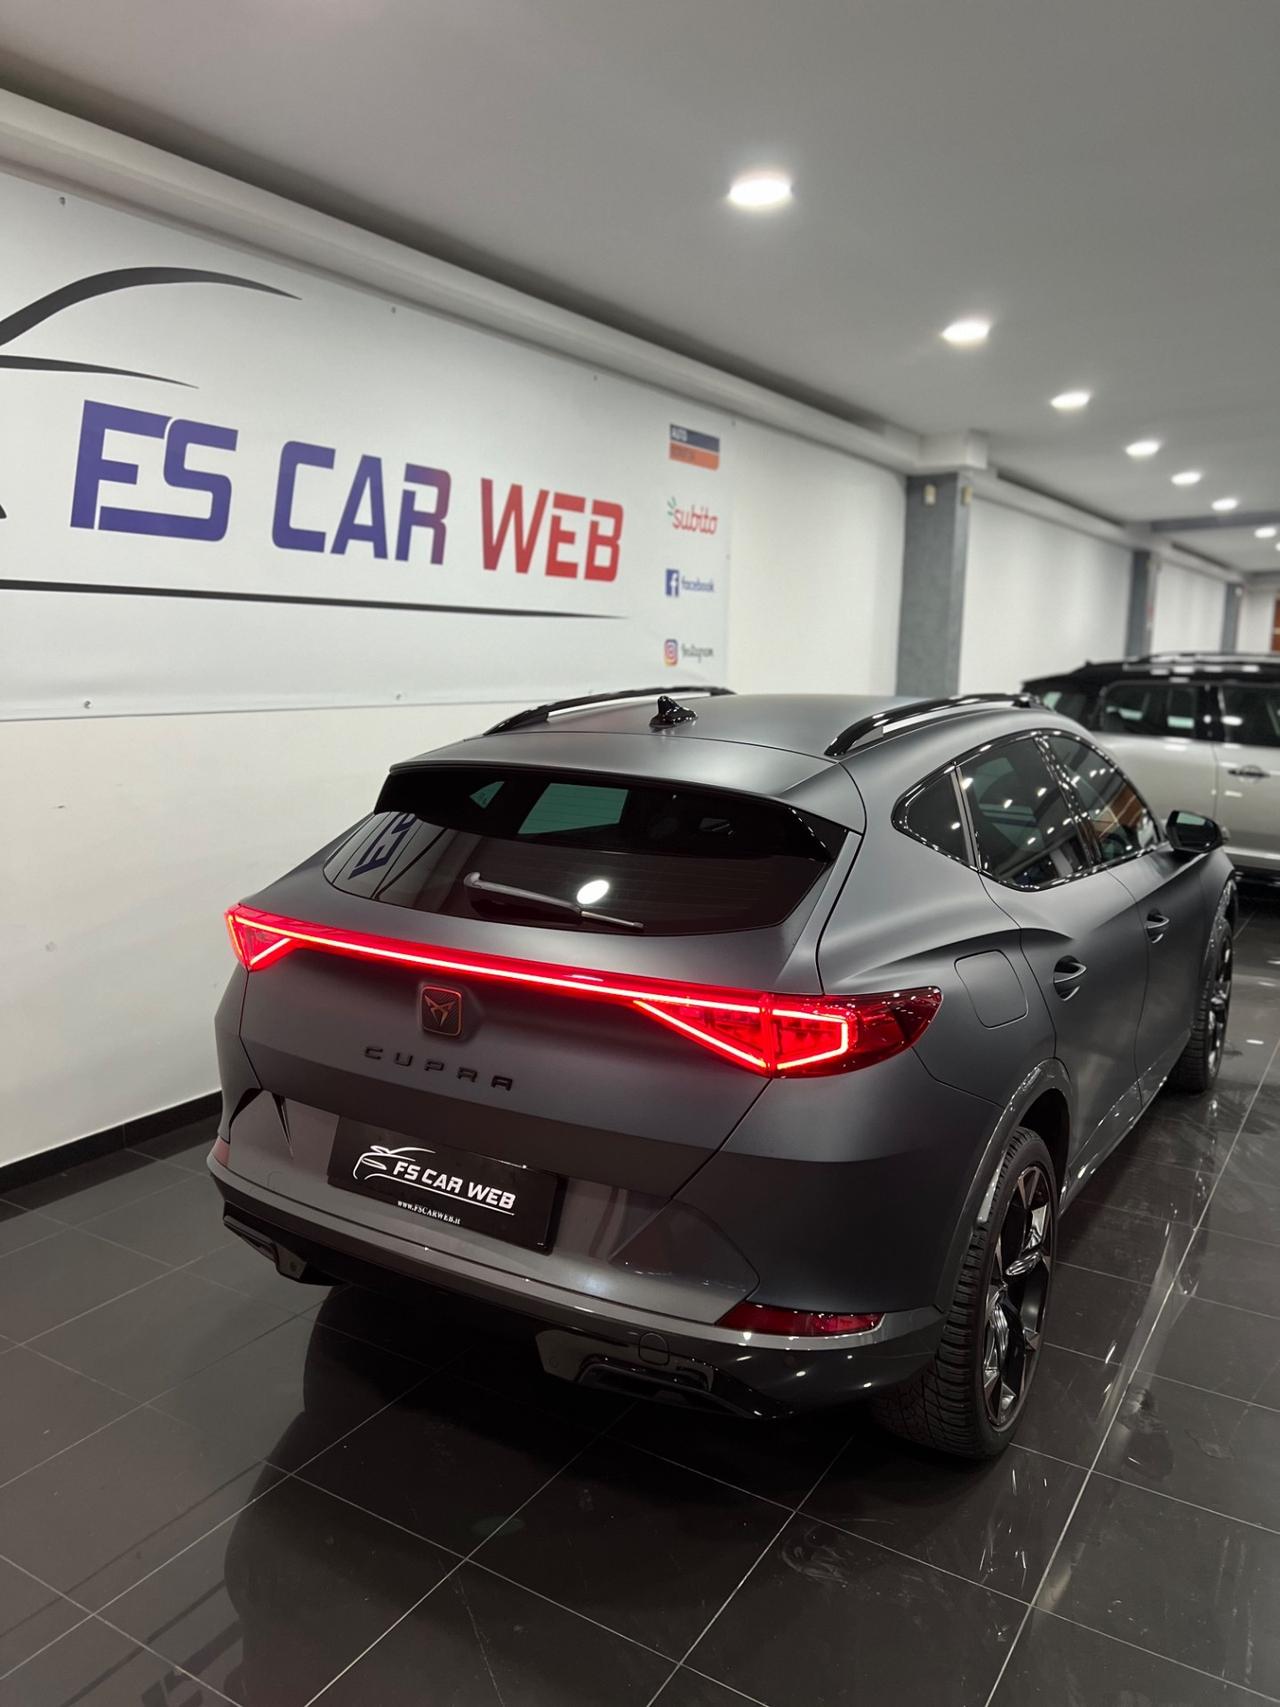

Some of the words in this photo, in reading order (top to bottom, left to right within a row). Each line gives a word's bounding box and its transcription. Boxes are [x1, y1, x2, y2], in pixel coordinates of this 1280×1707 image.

[70, 400, 238, 542] FS
[272, 440, 451, 565] CAR
[480, 478, 624, 583] WEB
[672, 503, 718, 535] subito
[364, 1046, 513, 1091] CUPRA
[393, 1161, 421, 1181] FS
[421, 1168, 463, 1194] CAR
[467, 1182, 516, 1209] WEB
